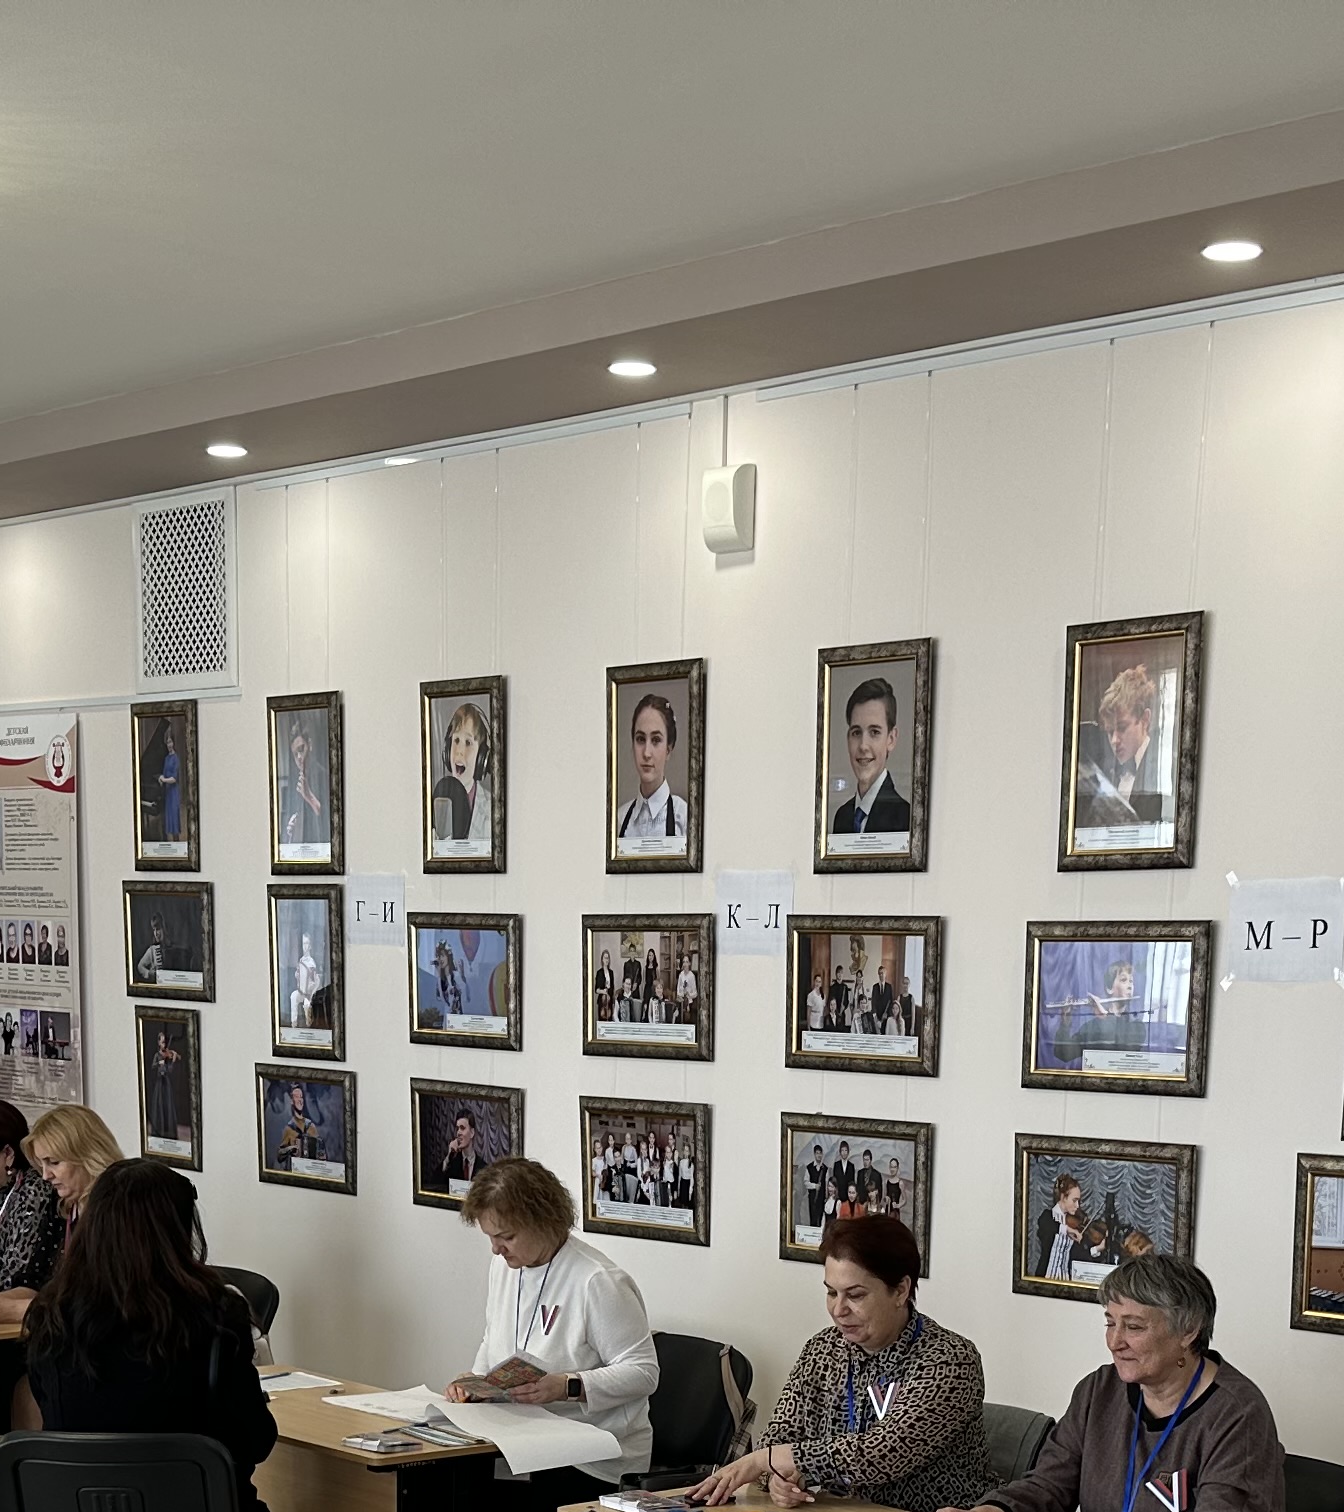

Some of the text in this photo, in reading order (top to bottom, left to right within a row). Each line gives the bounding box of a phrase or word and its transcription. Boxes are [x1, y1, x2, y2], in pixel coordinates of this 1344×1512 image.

[355, 900, 366, 922] Г
[382, 901, 395, 923] И
[726, 903, 742, 929] К
[764, 903, 781, 929] Л
[1244, 920, 1275, 951] М
[1309, 918, 1329, 949] Р
